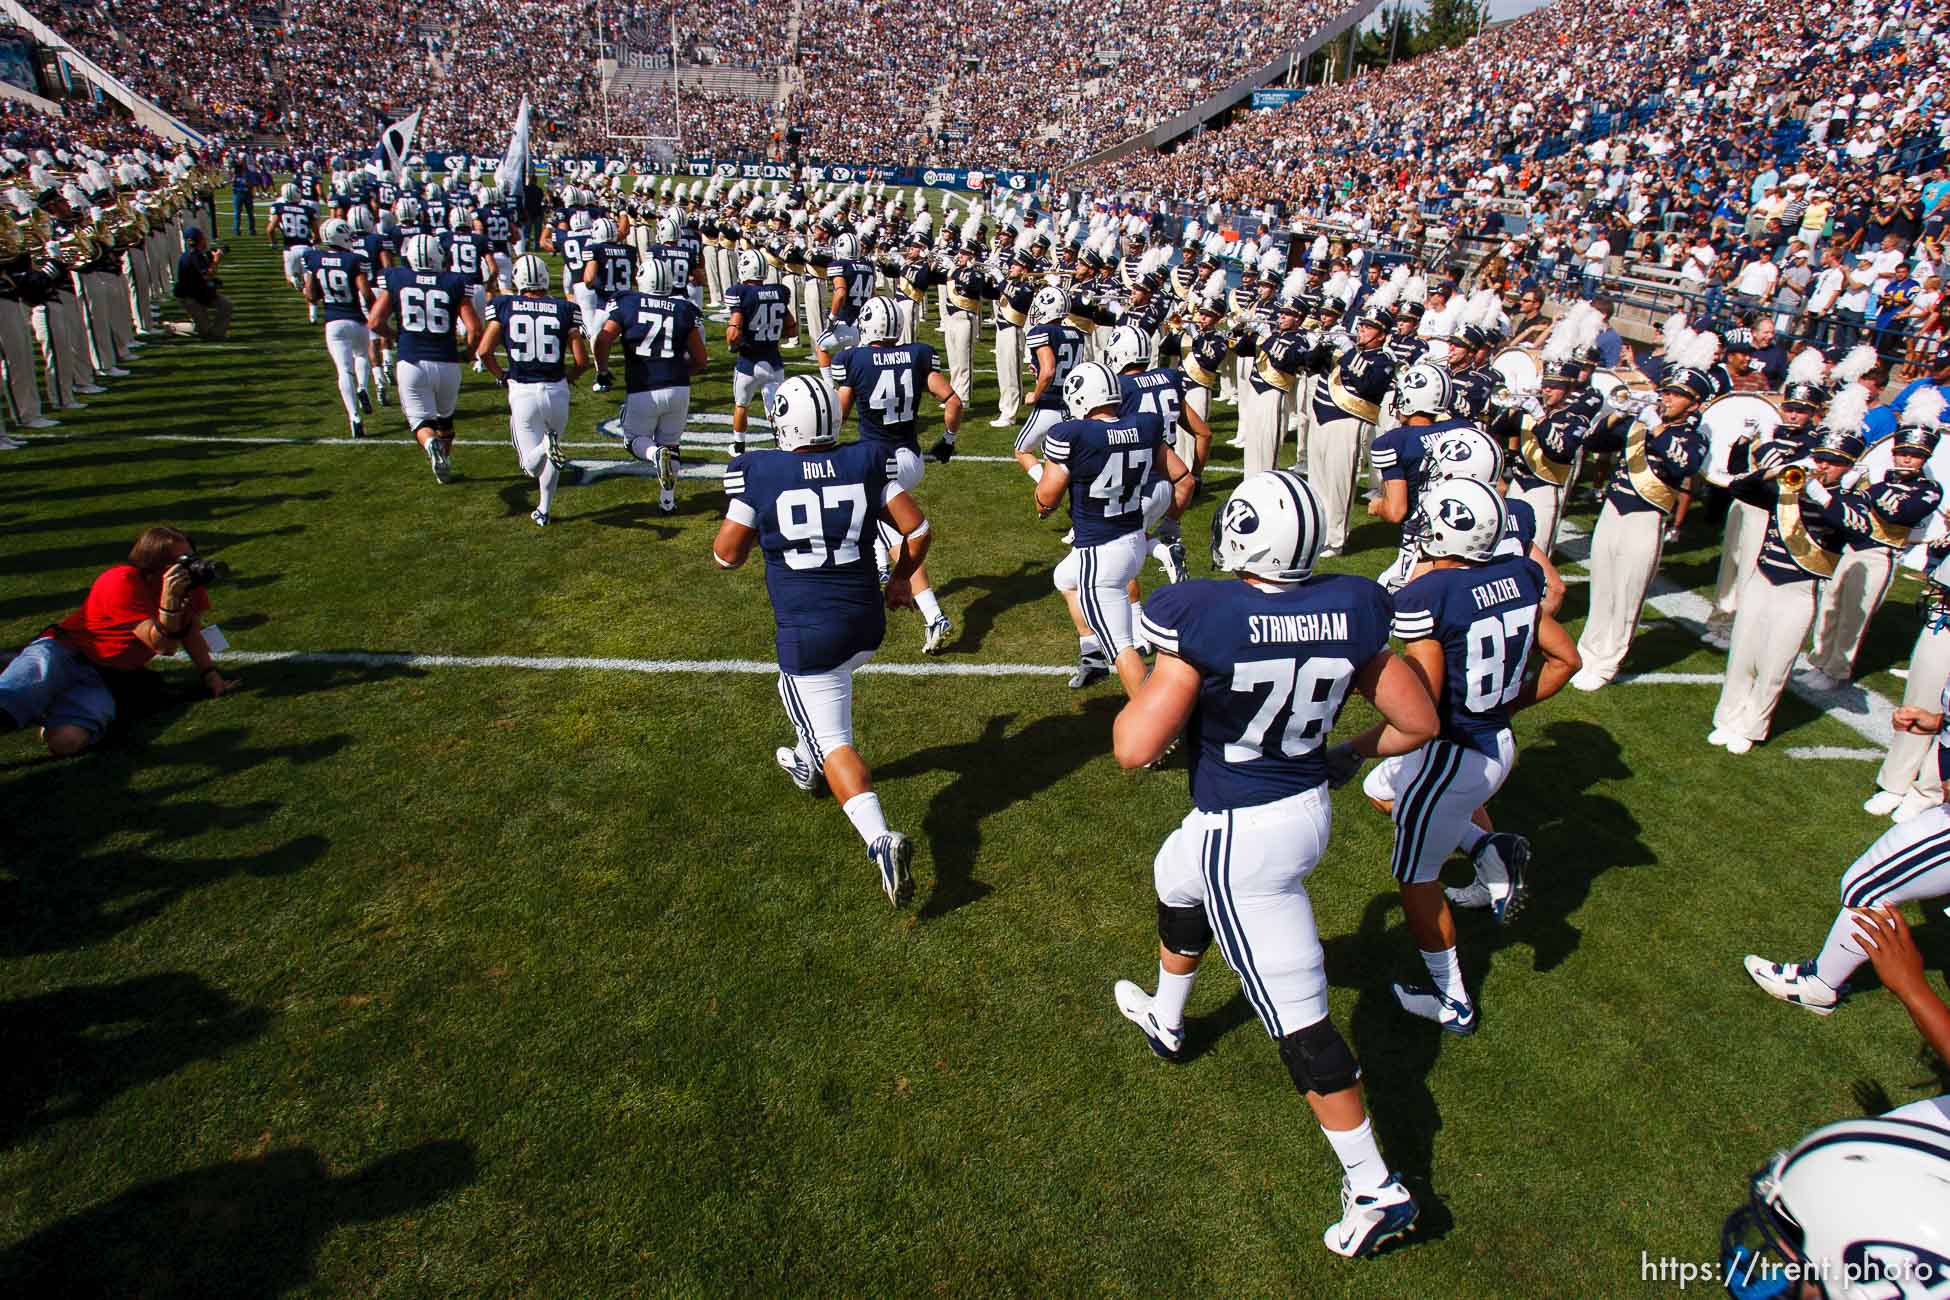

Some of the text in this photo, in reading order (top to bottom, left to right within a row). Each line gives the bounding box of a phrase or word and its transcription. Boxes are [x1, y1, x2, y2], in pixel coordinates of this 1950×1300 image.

[743, 165, 825, 180] HONR
[280, 213, 311, 239] 86
[450, 243, 477, 273] 19
[605, 258, 631, 291] 13
[317, 268, 351, 303] 19
[400, 287, 450, 333] 66
[749, 303, 785, 341] 46
[509, 315, 561, 363] 96
[636, 312, 675, 358] 71
[873, 351, 911, 366] CLAWSON
[869, 369, 914, 425] 41
[1106, 428, 1140, 446] HUNTER
[803, 459, 836, 480] HOLA
[1089, 448, 1153, 518] 47
[776, 483, 867, 570] 97
[1471, 576, 1521, 610] FRAZIER
[1249, 612, 1348, 644] STRINGHAM
[1465, 604, 1541, 713] 87
[1224, 657, 1355, 763] 78
